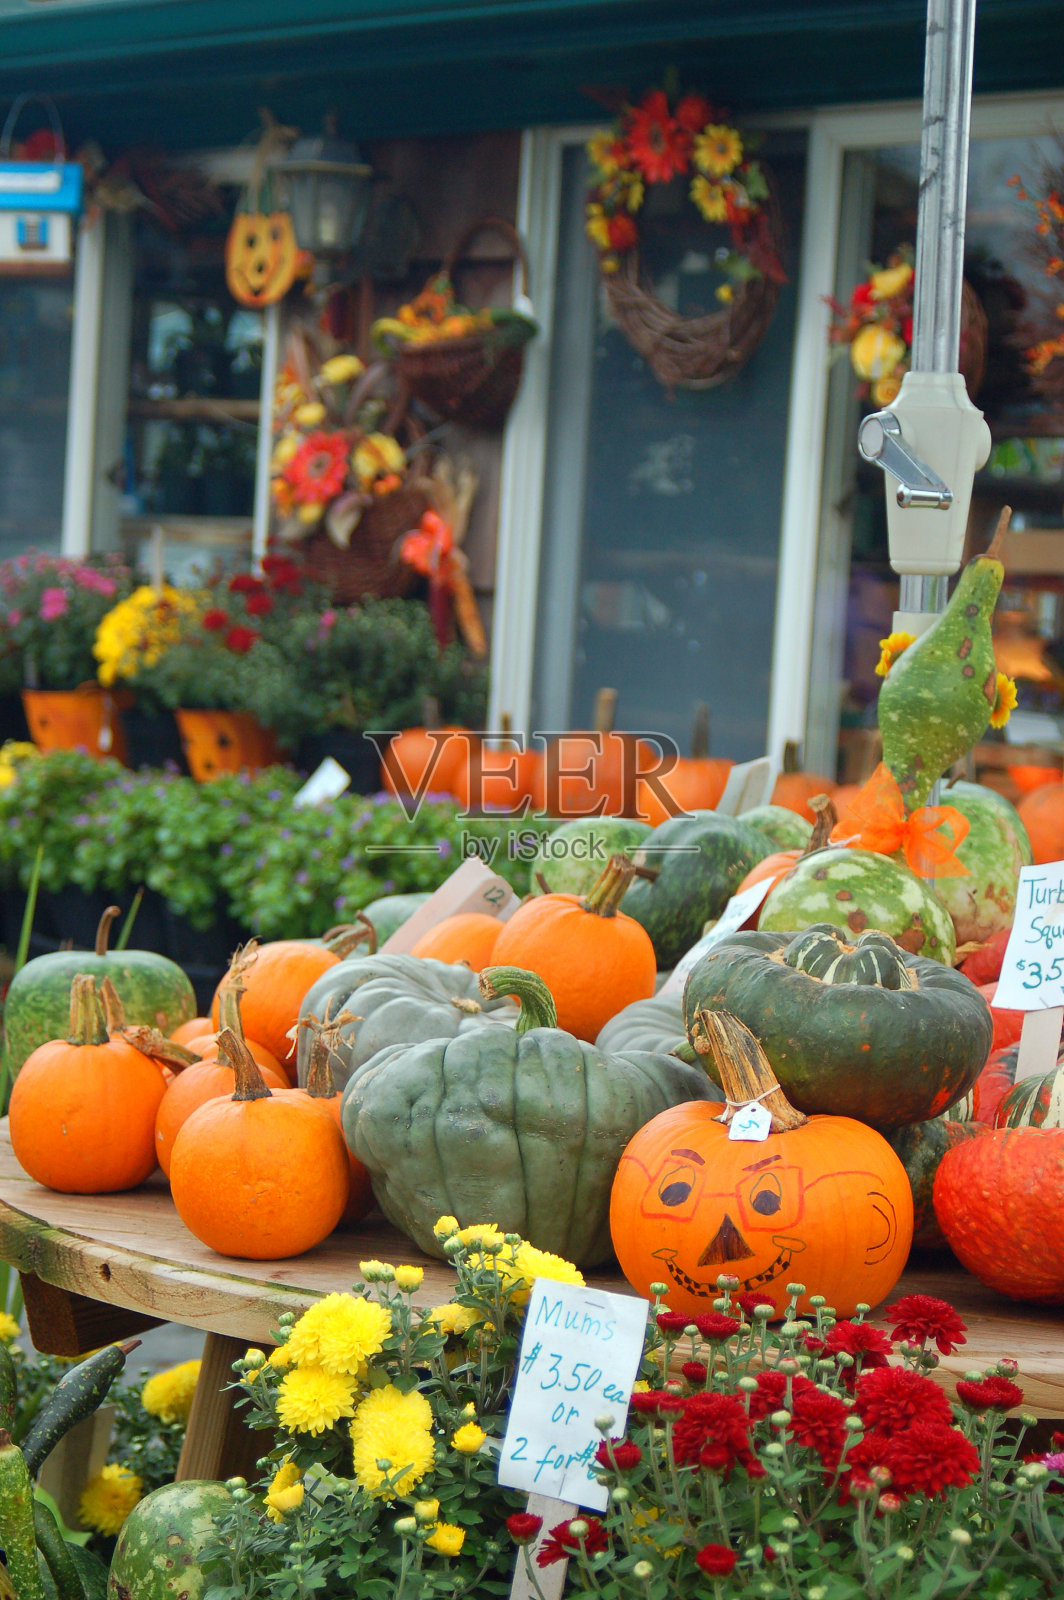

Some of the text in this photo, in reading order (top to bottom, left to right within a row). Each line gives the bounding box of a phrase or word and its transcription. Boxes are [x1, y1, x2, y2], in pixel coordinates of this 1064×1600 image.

[1024, 916, 1064, 949] Squ
[534, 1296, 617, 1342] Mums
[551, 1402, 580, 1425] or
[510, 1437, 528, 1461] 2
